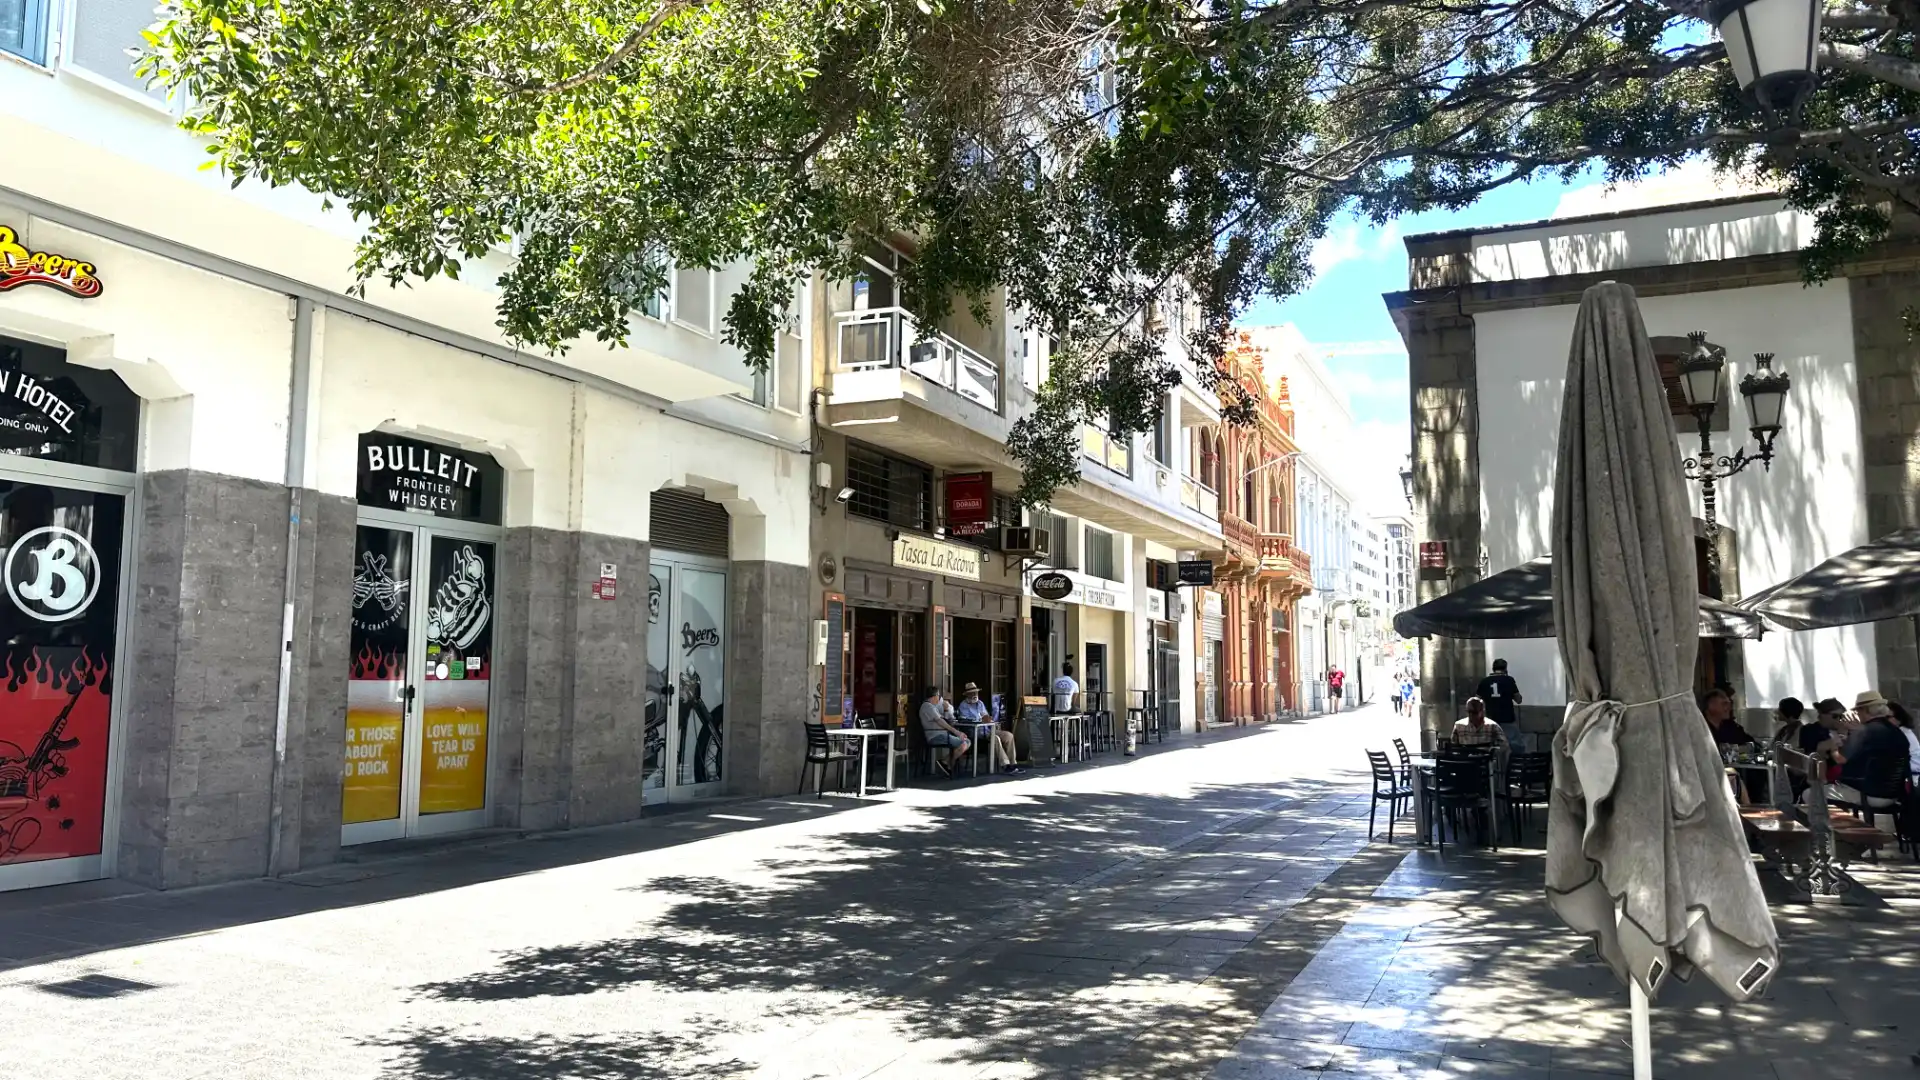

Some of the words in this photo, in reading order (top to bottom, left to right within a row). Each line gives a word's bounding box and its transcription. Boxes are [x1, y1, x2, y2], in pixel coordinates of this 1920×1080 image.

[0, 225, 102, 297] Beers
[14, 373, 75, 434] HOTEL
[24, 422, 49, 434] ONLY
[367, 445, 478, 488] BULLEIT
[396, 476, 451, 495] FRONTIER
[389, 489, 457, 512] WHISKEY
[956, 500, 979, 508] DORADA
[901, 539, 928, 565] Tasca
[931, 546, 944, 568] La
[368, 620, 389, 631] CRAFT
[681, 621, 719, 657] Beers
[1490, 682, 1501, 698] 1
[359, 726, 397, 742] THOSE
[426, 724, 454, 739] LOVE
[457, 723, 482, 736] WILL
[344, 743, 384, 760] ABOUT
[432, 739, 459, 754] TEAR
[462, 738, 476, 752] US
[357, 760, 389, 776] ROCK
[436, 754, 469, 770] APART
